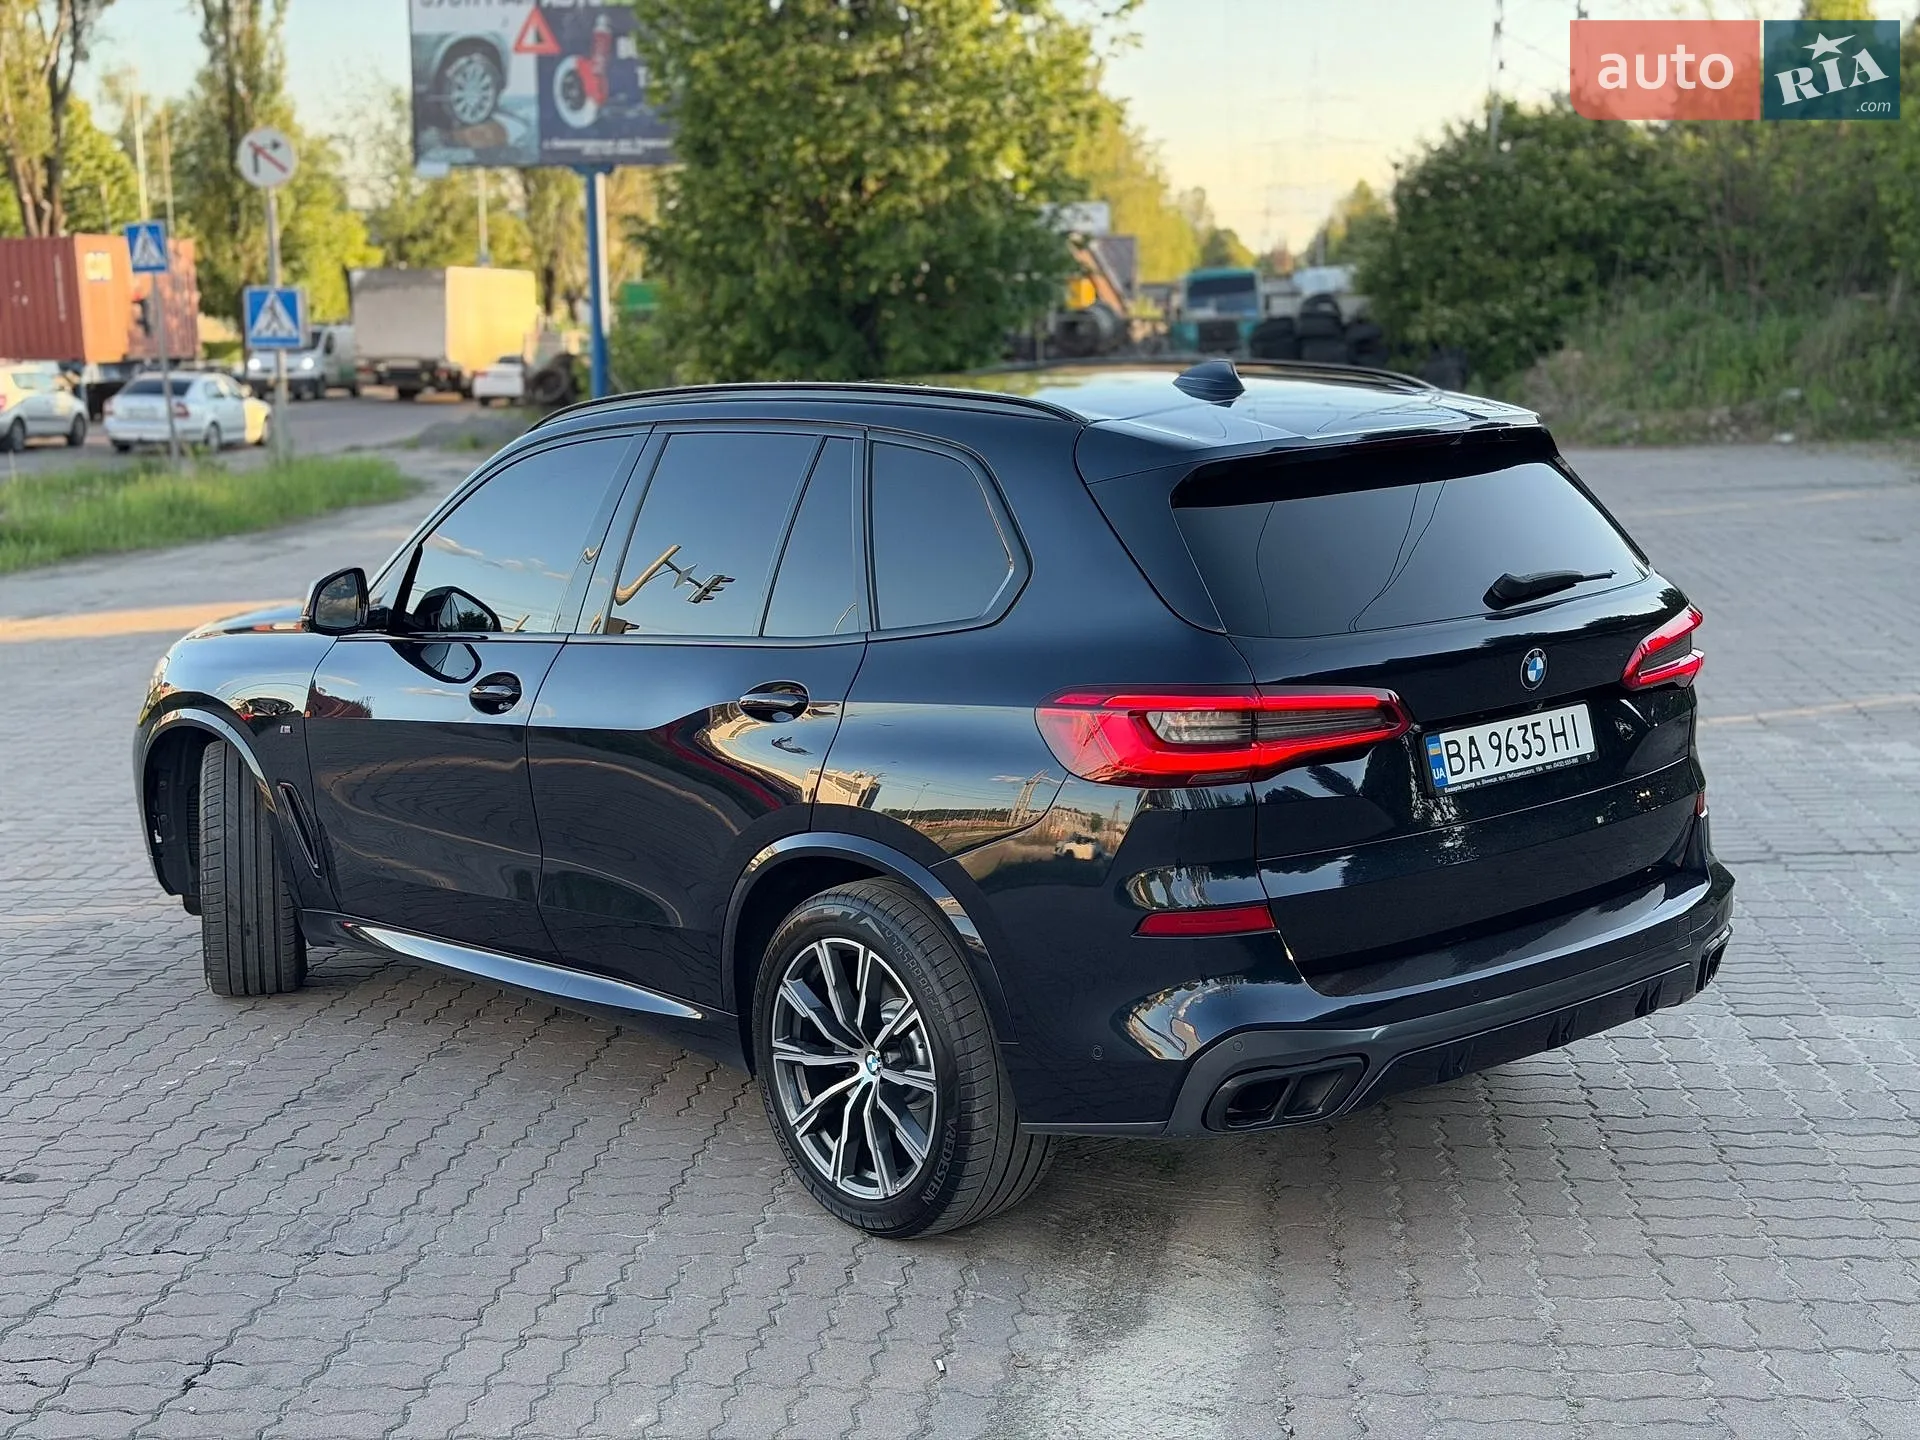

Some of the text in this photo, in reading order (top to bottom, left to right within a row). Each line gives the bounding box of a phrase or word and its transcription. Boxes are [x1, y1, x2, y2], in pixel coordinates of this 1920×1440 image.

[1432, 767, 1446, 780] UA
[1444, 714, 1581, 777] BA 9635 HI
[921, 1117, 958, 1206] VREDESTEIN
